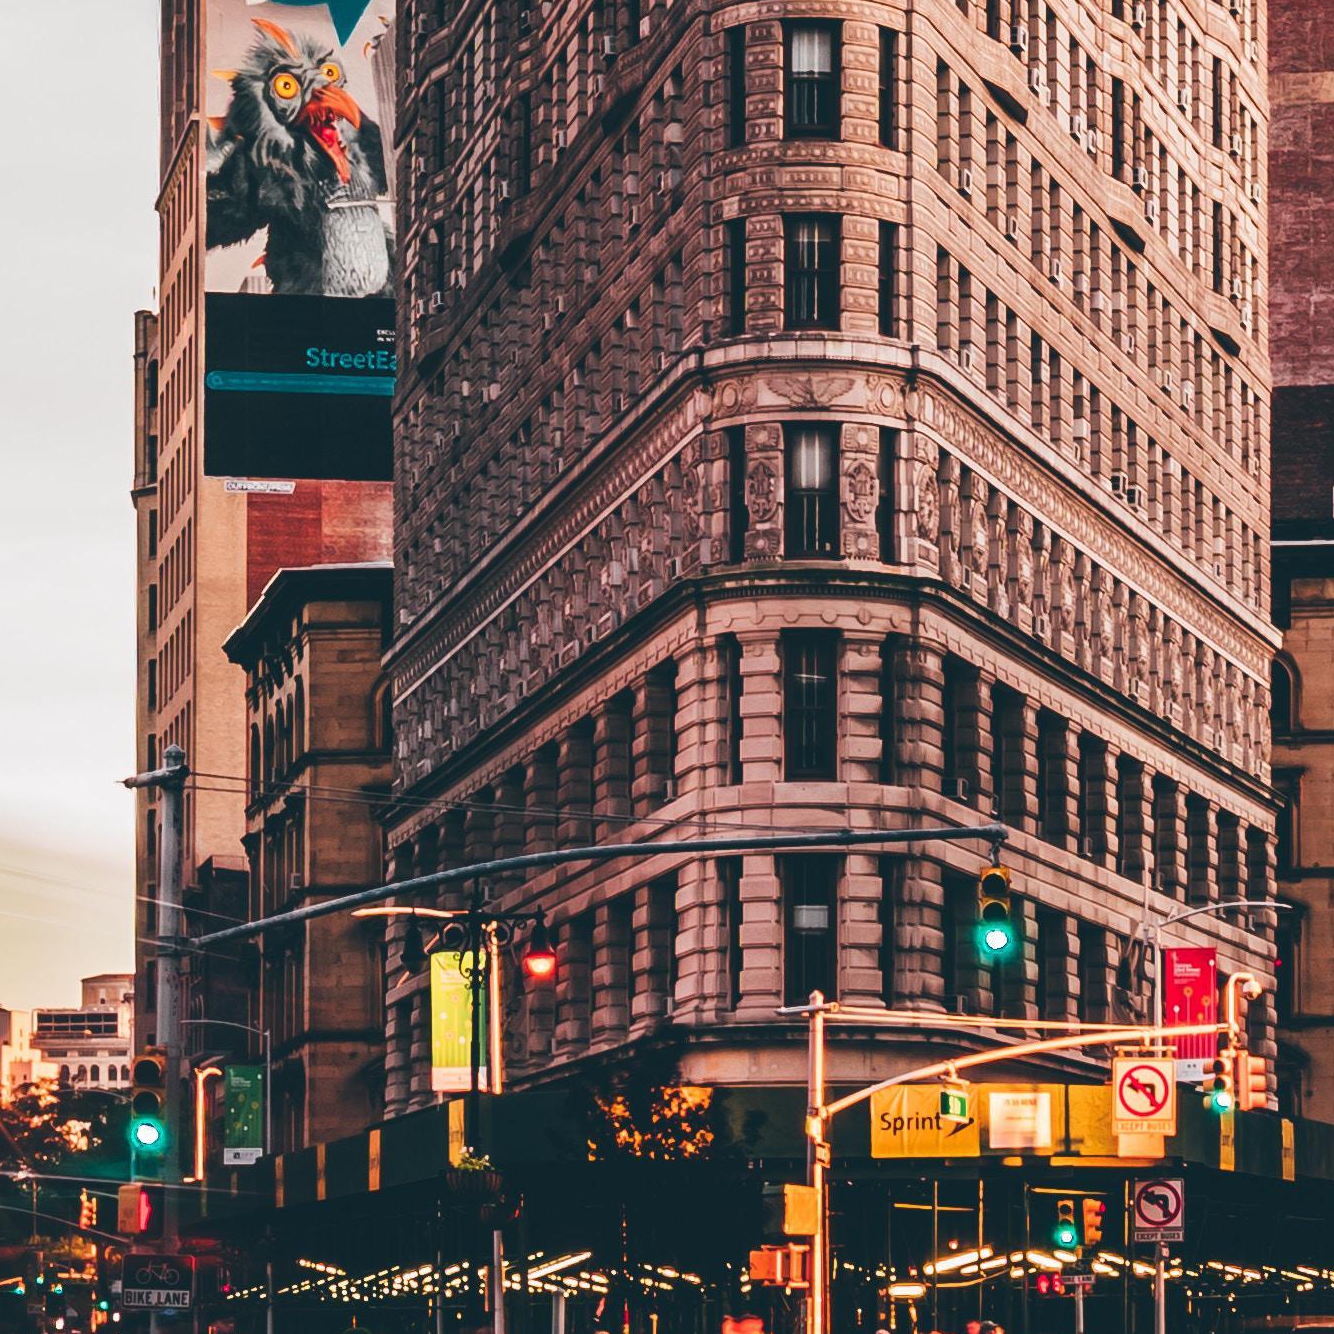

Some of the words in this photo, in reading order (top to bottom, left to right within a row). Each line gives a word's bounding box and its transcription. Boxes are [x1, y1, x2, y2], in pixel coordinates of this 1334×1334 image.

[307, 347, 397, 370] StreetEa
[880, 1111, 943, 1136] Sprint
[125, 1290, 153, 1305] BIKE
[155, 1291, 188, 1306] LANE
